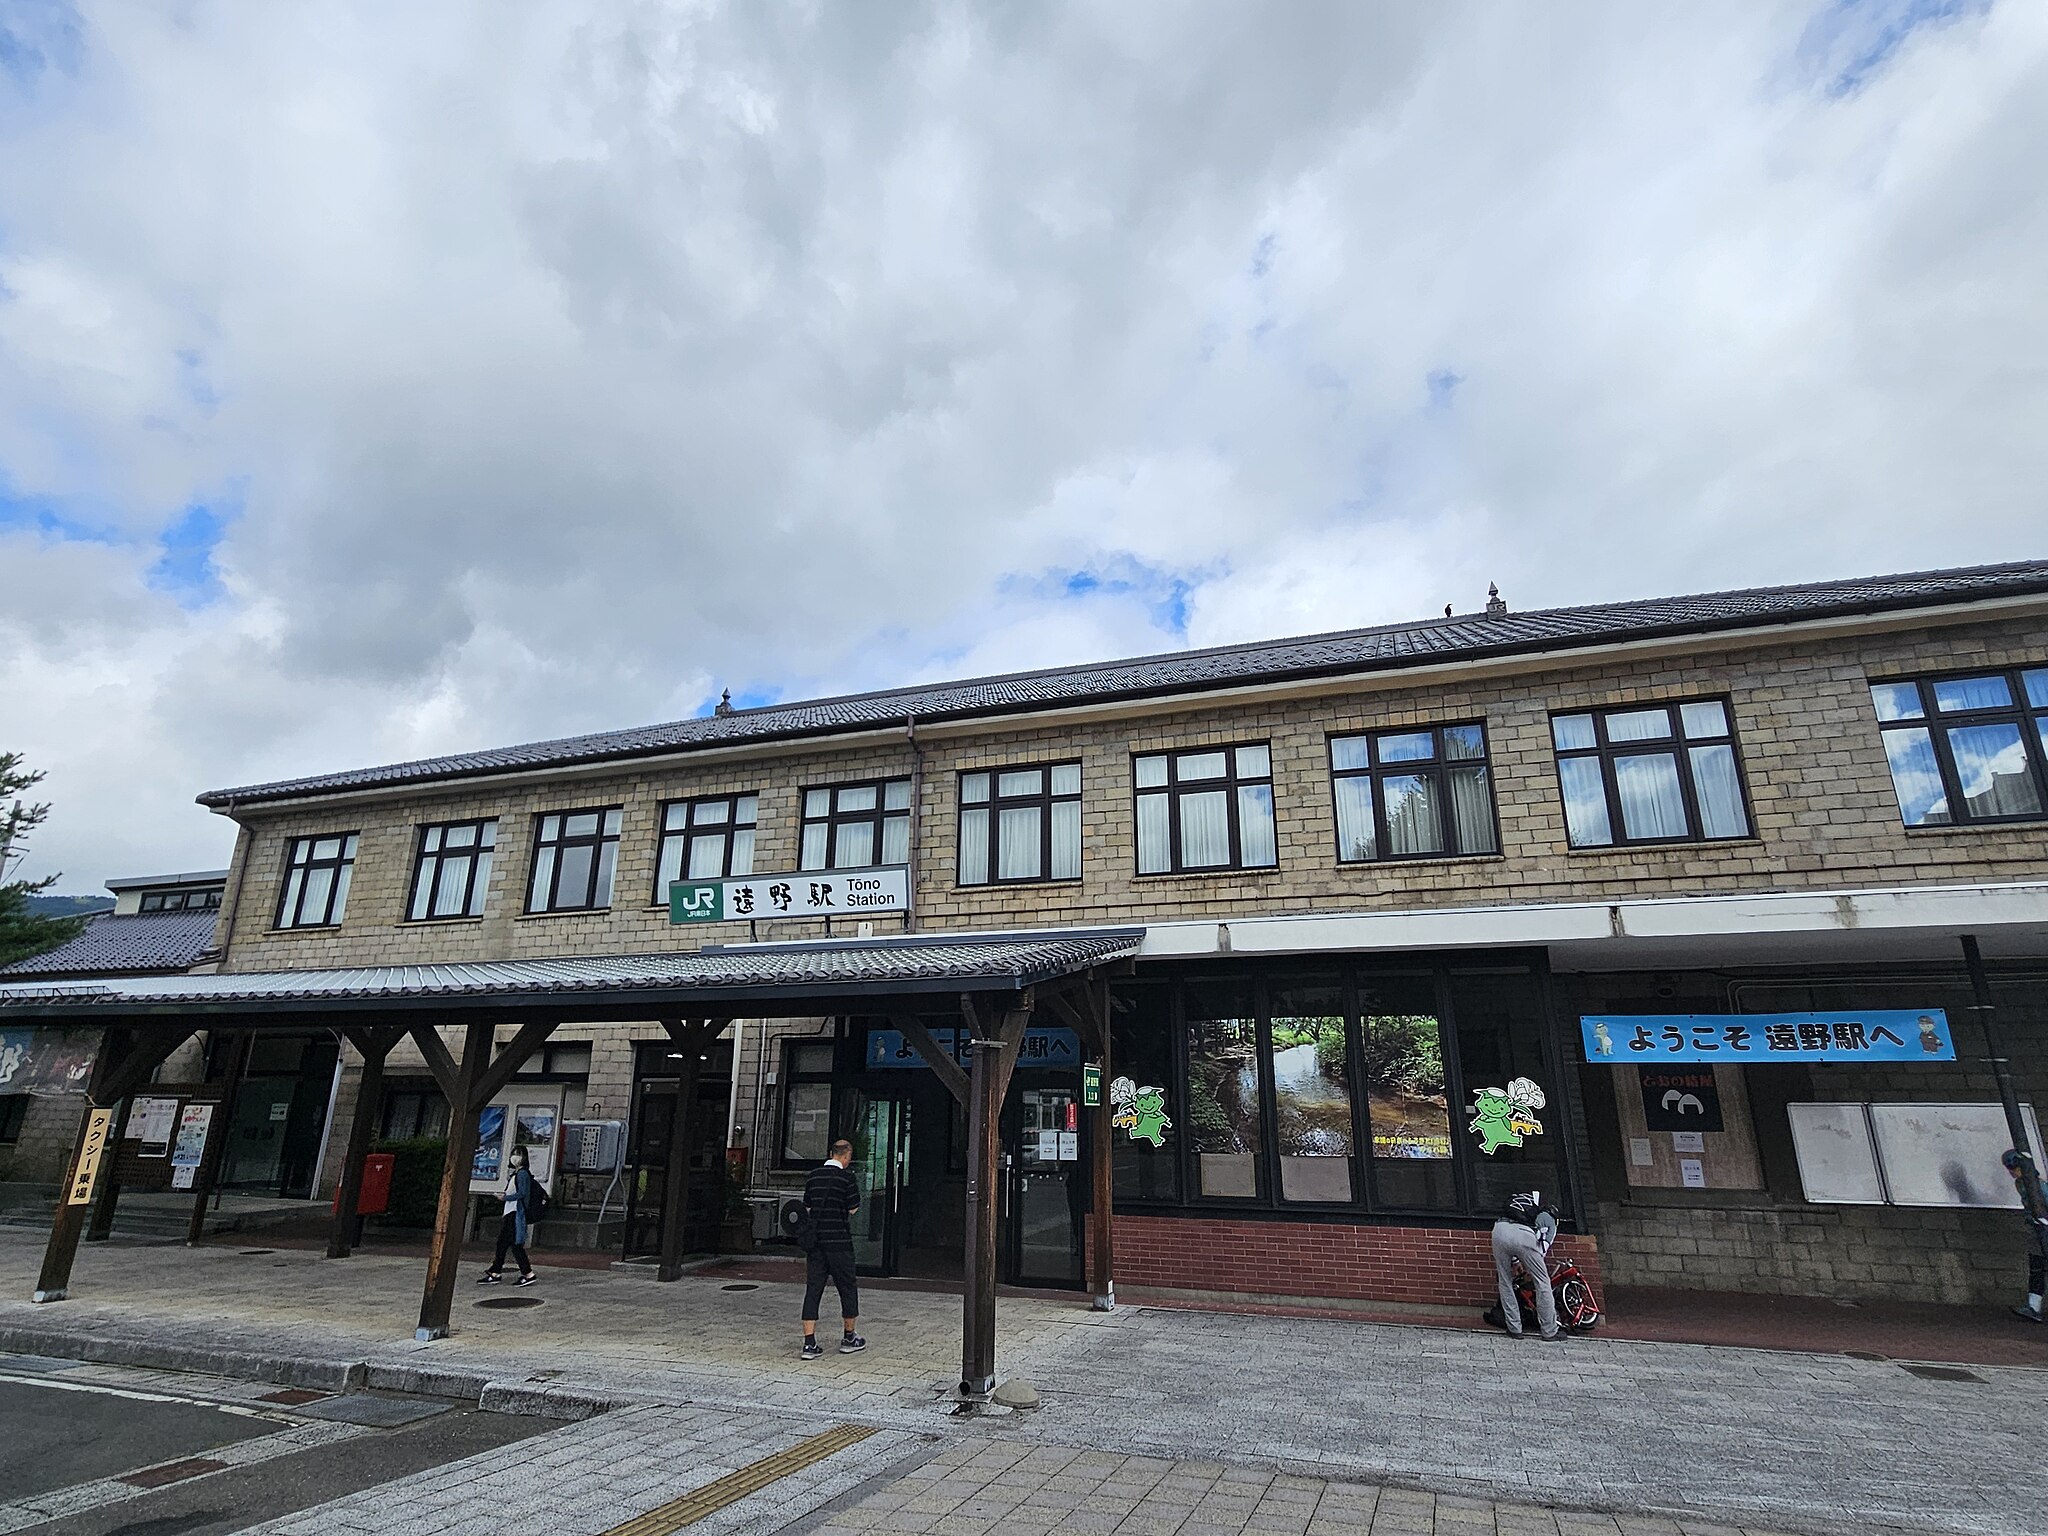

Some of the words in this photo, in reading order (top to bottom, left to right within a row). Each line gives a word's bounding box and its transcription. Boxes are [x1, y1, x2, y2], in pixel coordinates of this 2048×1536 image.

[682, 887, 716, 910] JR
[732, 882, 836, 915] 遠野駅
[846, 878, 881, 892] Tōno
[846, 892, 896, 908] Station
[1628, 1025, 1752, 1053] ようこそ
[1764, 1022, 1905, 1052] 遠野駅へ
[73, 1116, 106, 1200] タクシー乗場
